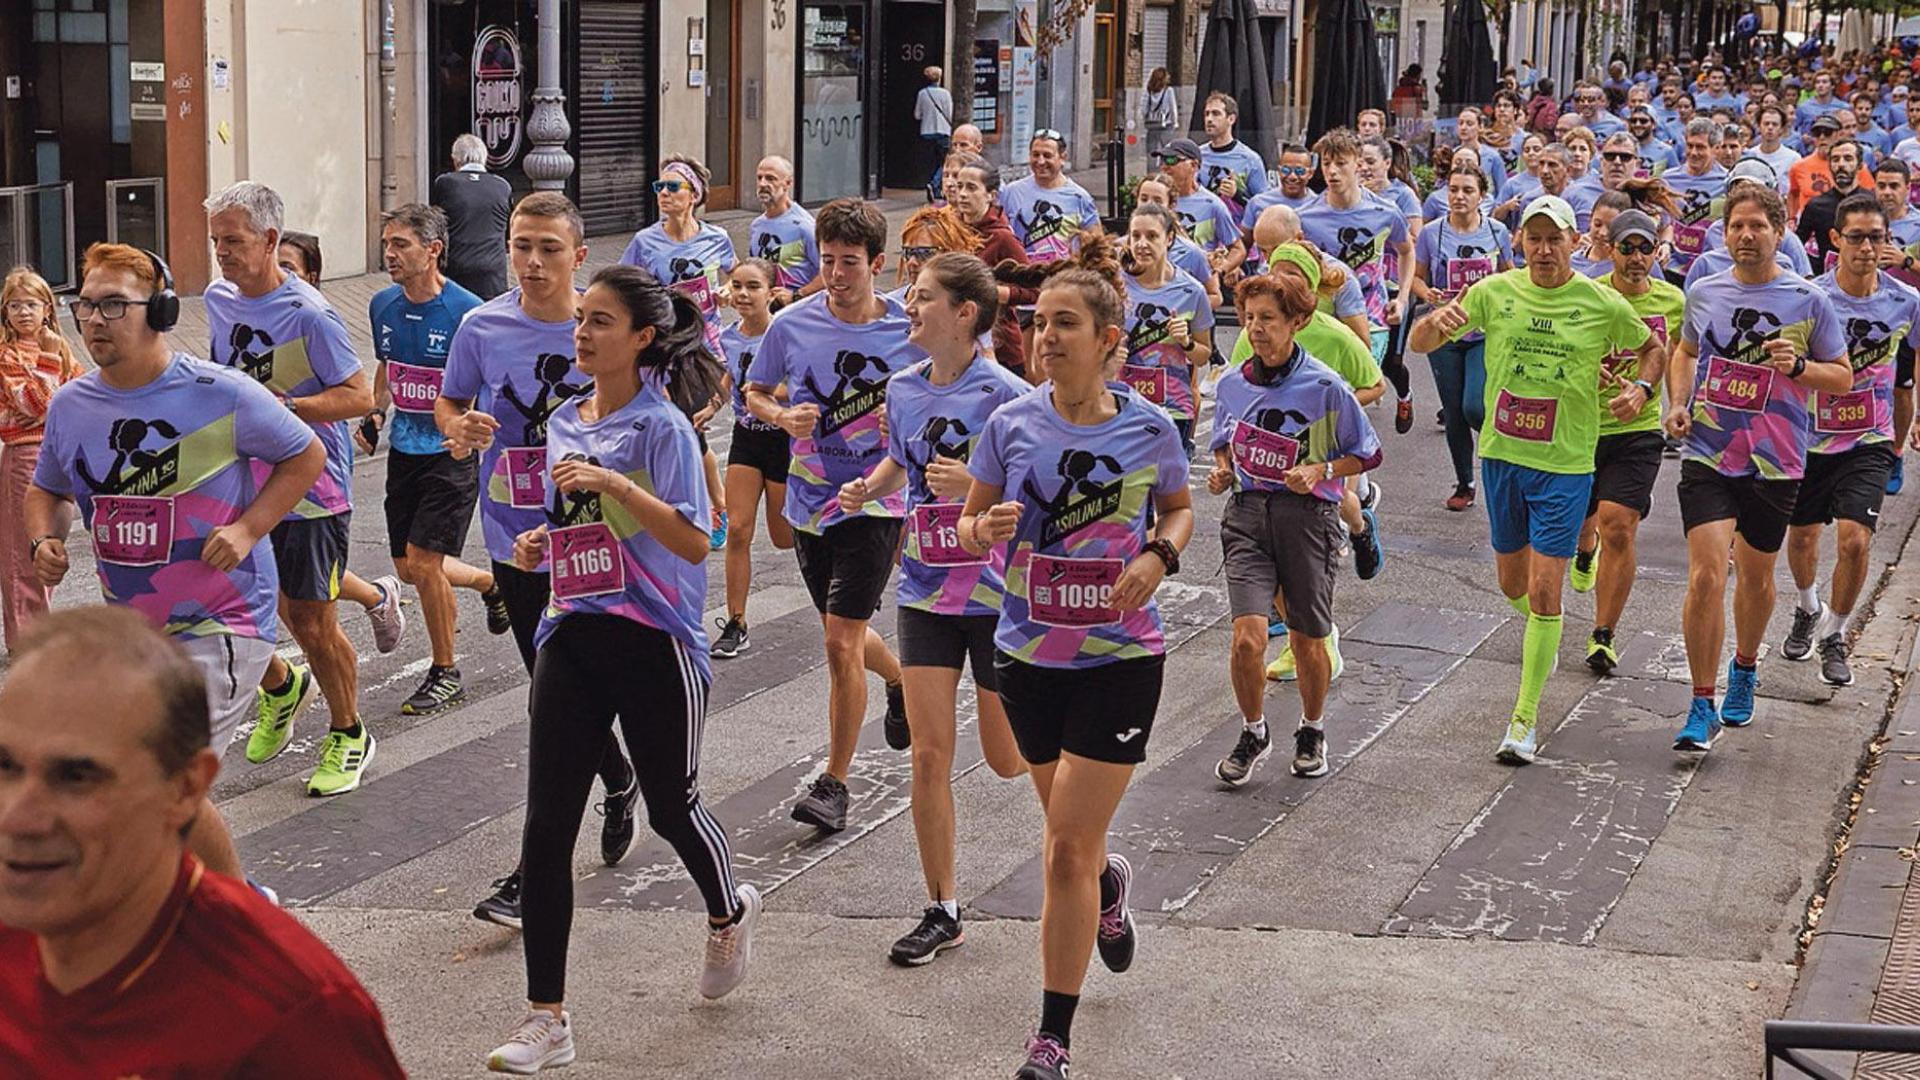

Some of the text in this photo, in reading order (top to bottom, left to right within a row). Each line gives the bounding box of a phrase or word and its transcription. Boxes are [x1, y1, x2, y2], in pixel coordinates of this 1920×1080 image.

[771, 0, 787, 30] 36
[901, 43, 925, 61] 36
[401, 382, 438, 400] 1066
[1134, 380, 1156, 395] 123
[1727, 379, 1759, 401] 484
[1515, 412, 1547, 430] 356
[1838, 404, 1867, 422] 339
[1249, 446, 1288, 470] 1305
[116, 521, 158, 546] 1191
[937, 525, 958, 549] 13
[570, 547, 613, 577] 1166
[1057, 584, 1114, 609] 1099
